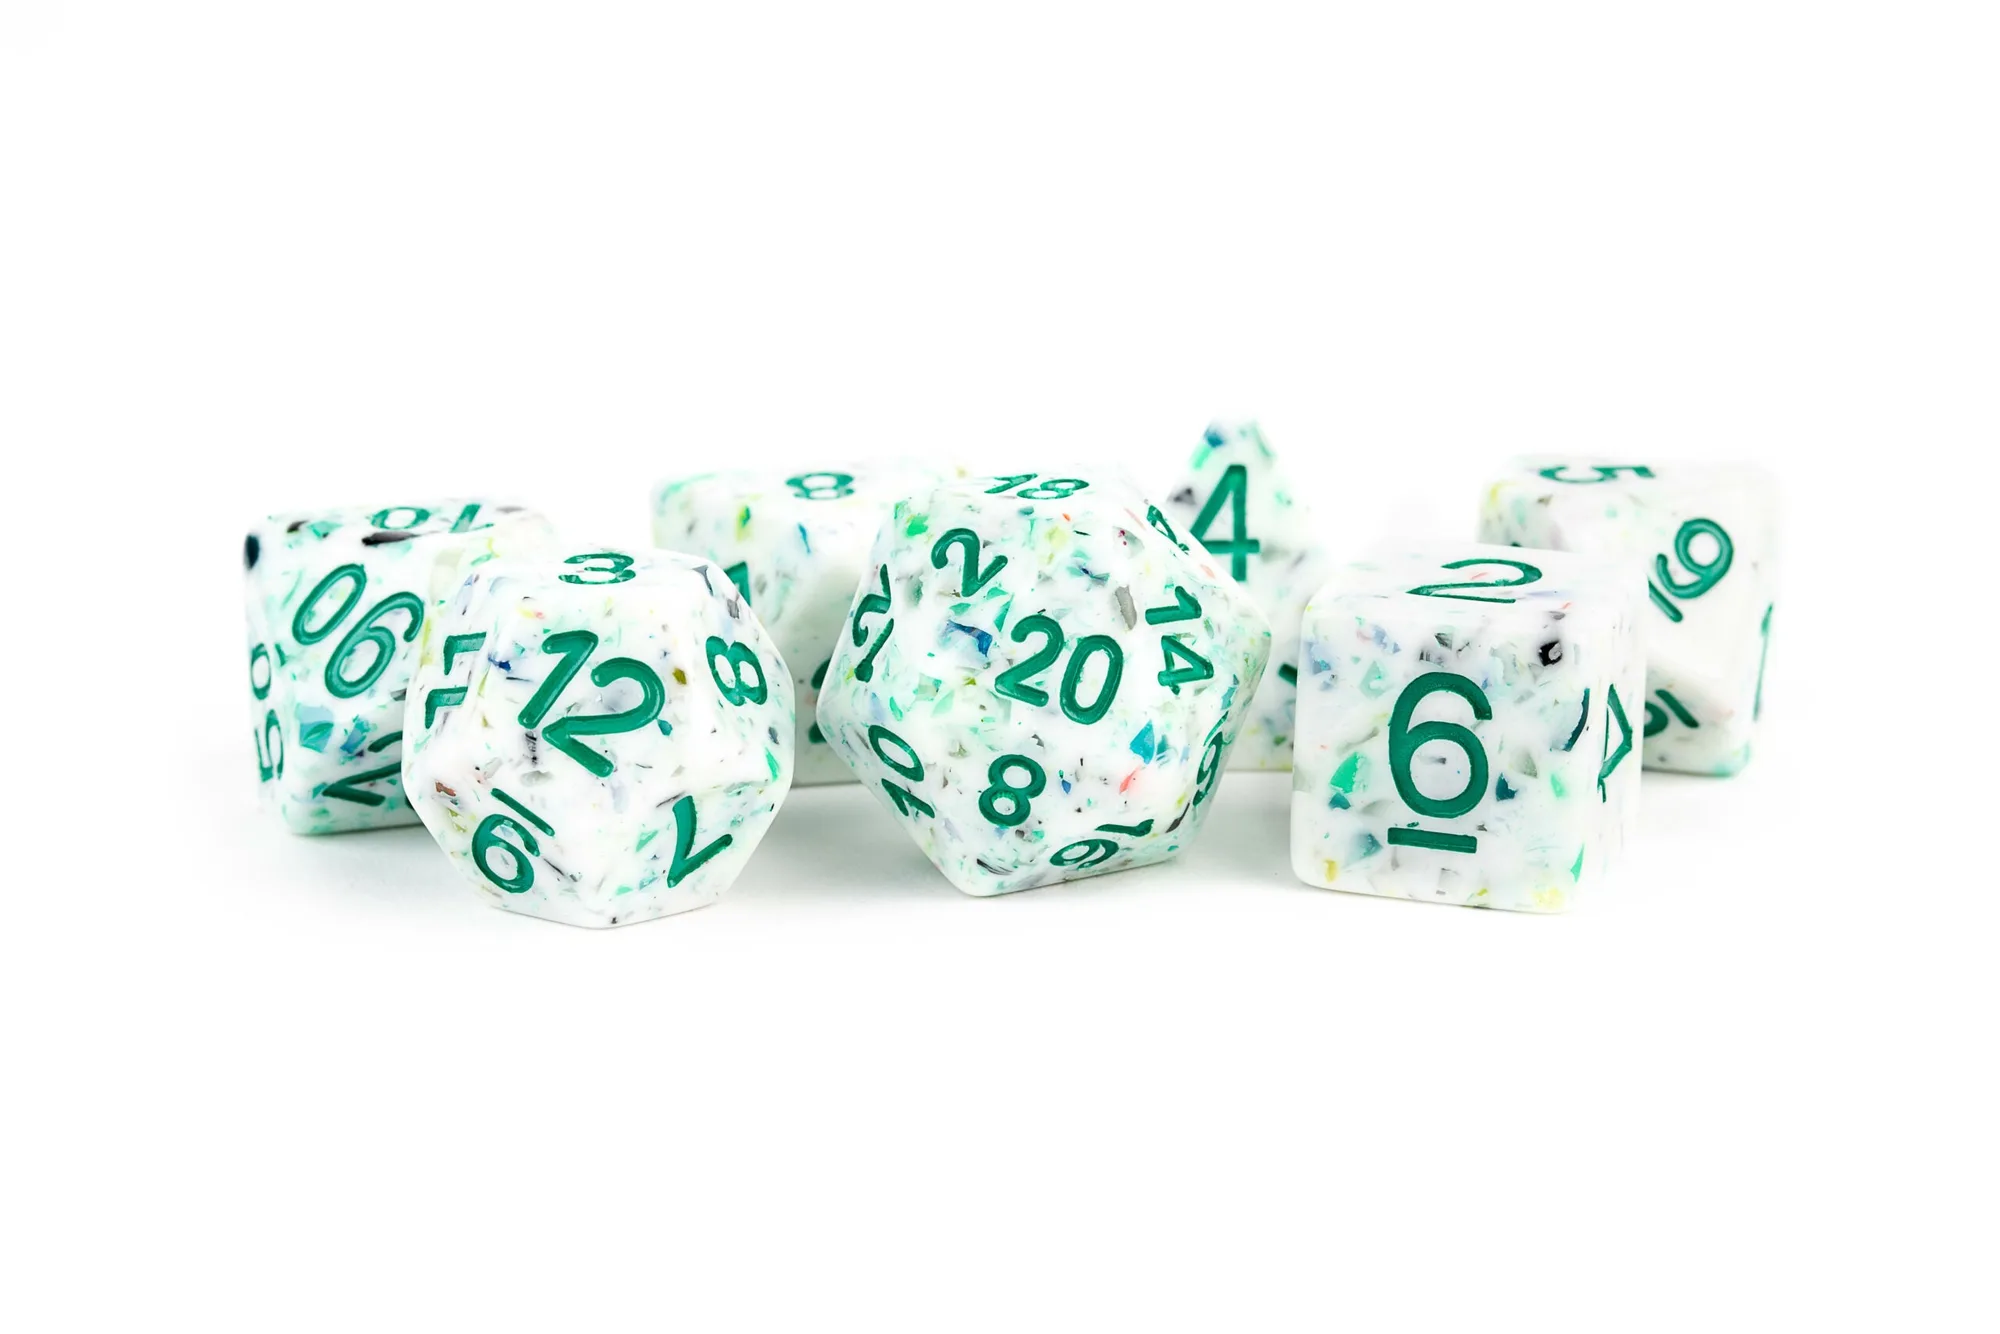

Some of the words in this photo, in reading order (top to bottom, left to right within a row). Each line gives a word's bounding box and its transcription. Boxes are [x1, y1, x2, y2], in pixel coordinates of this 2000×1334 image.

[785, 472, 855, 500] 8
[985, 473, 1090, 500] 18
[1189, 464, 1260, 582] 4
[558, 552, 636, 585] 3
[932, 528, 1008, 598] 2
[1406, 558, 1543, 604] 2
[705, 636, 768, 707] 8
[995, 614, 1124, 725] 20
[1145, 586, 1215, 696] 14
[518, 630, 665, 778] 12
[867, 724, 935, 819] 10
[1388, 672, 1493, 819] 6
[978, 754, 1047, 827] 8
[667, 795, 733, 888] 7
[1050, 819, 1154, 870] 16
